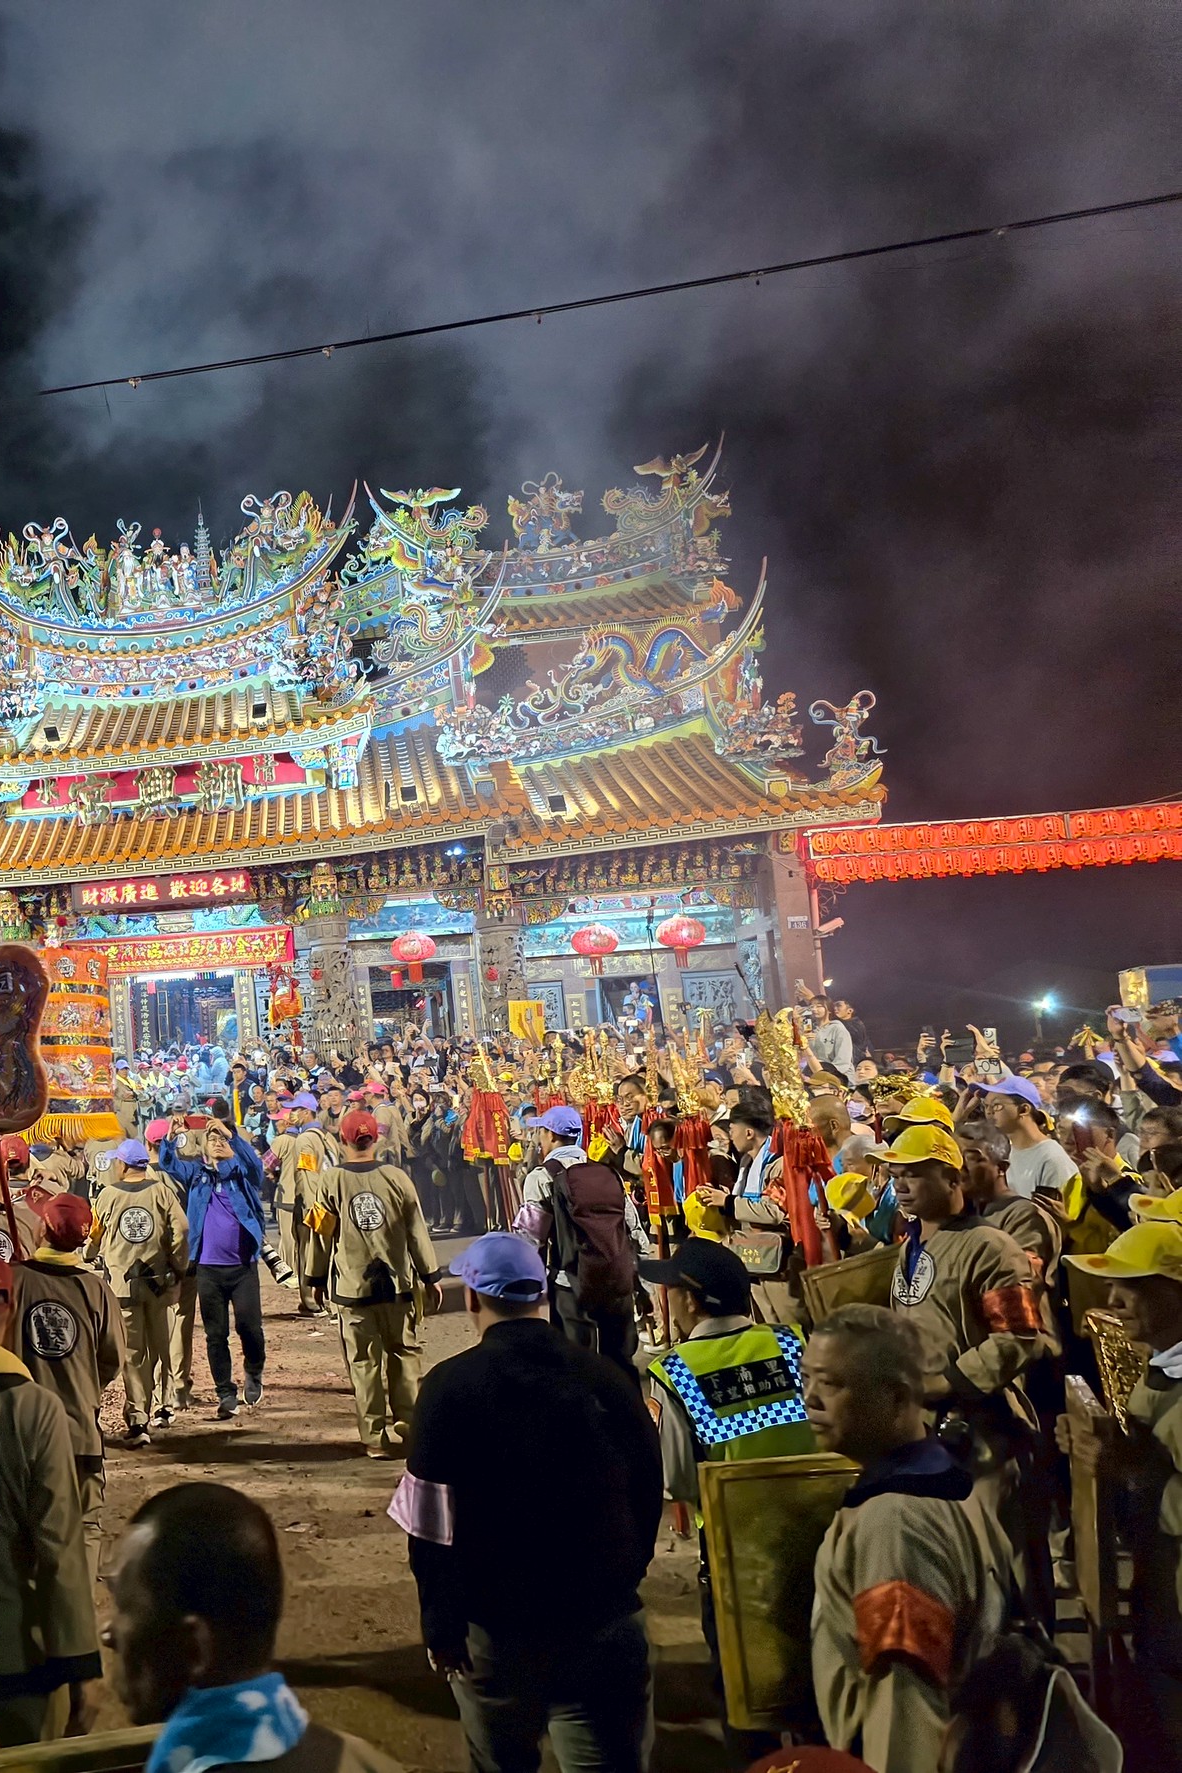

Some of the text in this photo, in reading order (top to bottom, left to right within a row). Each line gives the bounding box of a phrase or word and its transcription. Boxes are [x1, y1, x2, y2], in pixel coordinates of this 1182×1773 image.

[82, 874, 246, 905] 財源廣進 歡迎各地
[704, 1360, 783, 1389] 下湳里
[711, 1373, 789, 1404] 守望相助隊
